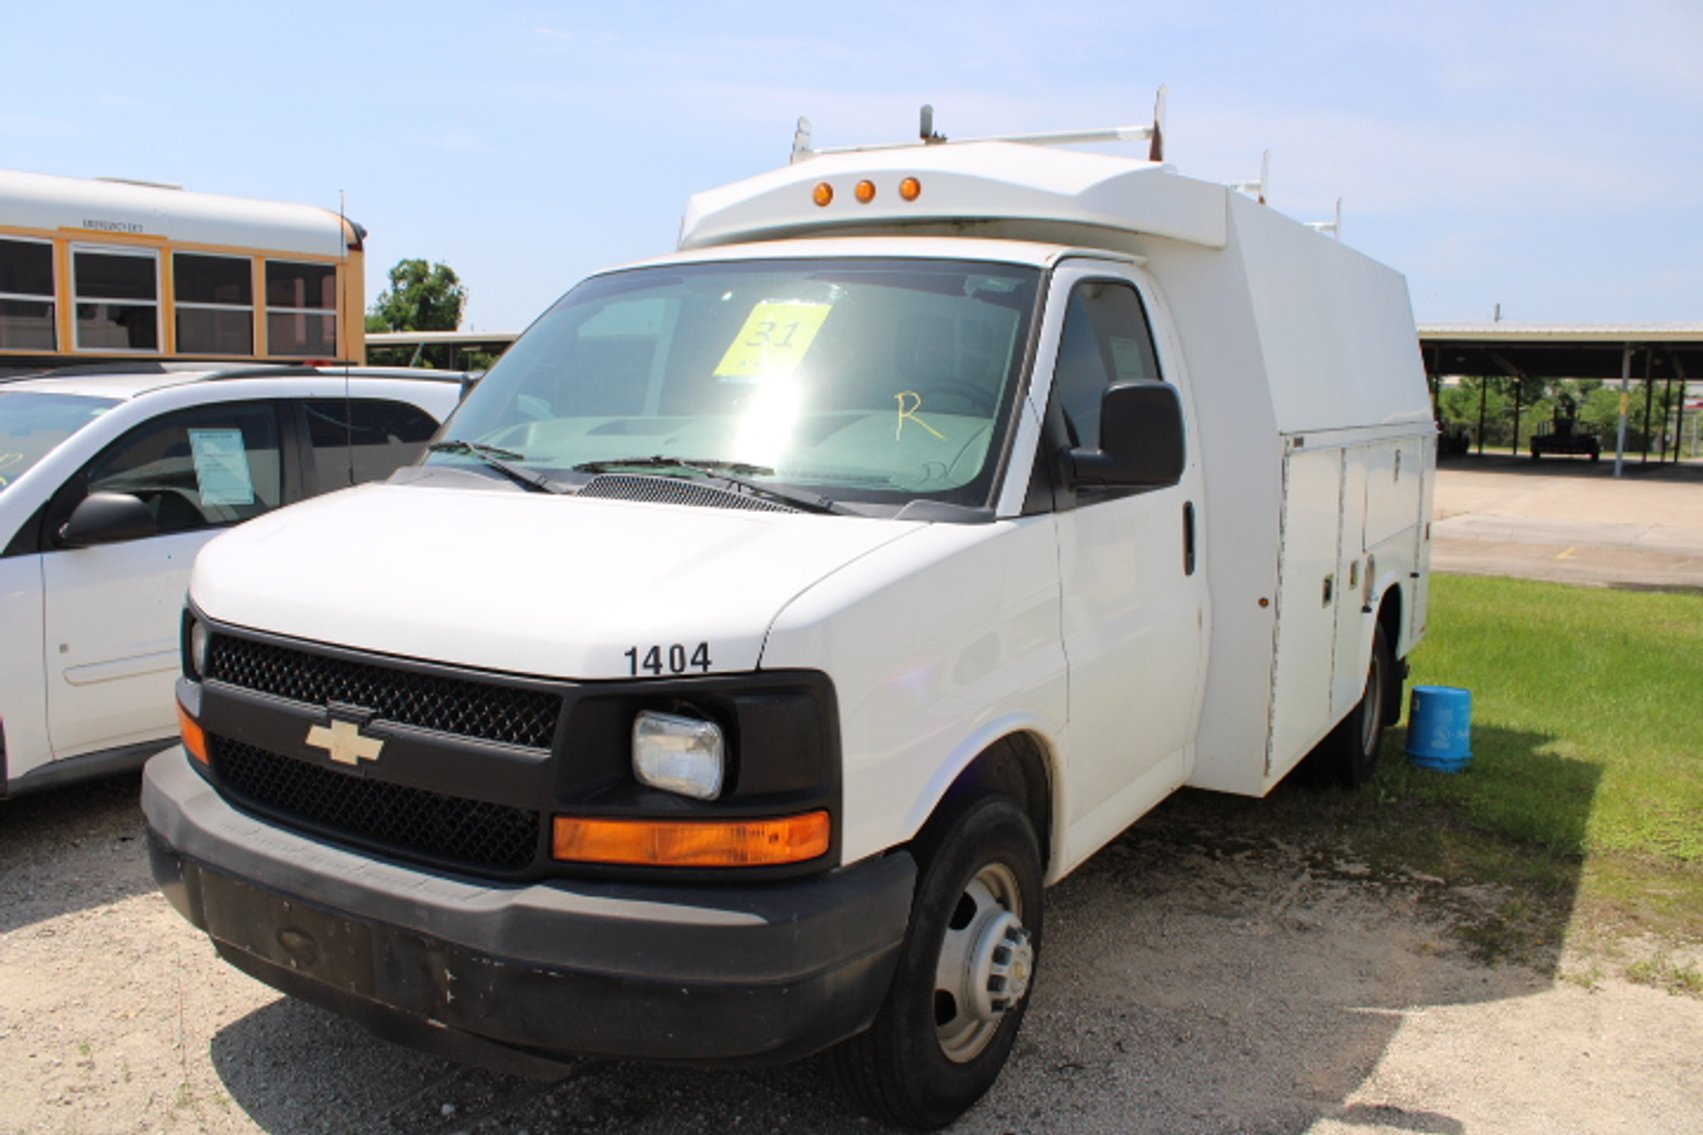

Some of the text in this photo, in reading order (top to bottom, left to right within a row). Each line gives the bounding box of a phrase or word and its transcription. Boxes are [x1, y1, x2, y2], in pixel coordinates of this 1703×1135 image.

[745, 321, 800, 347] 31
[894, 390, 945, 440] R
[624, 642, 712, 676] 1404
